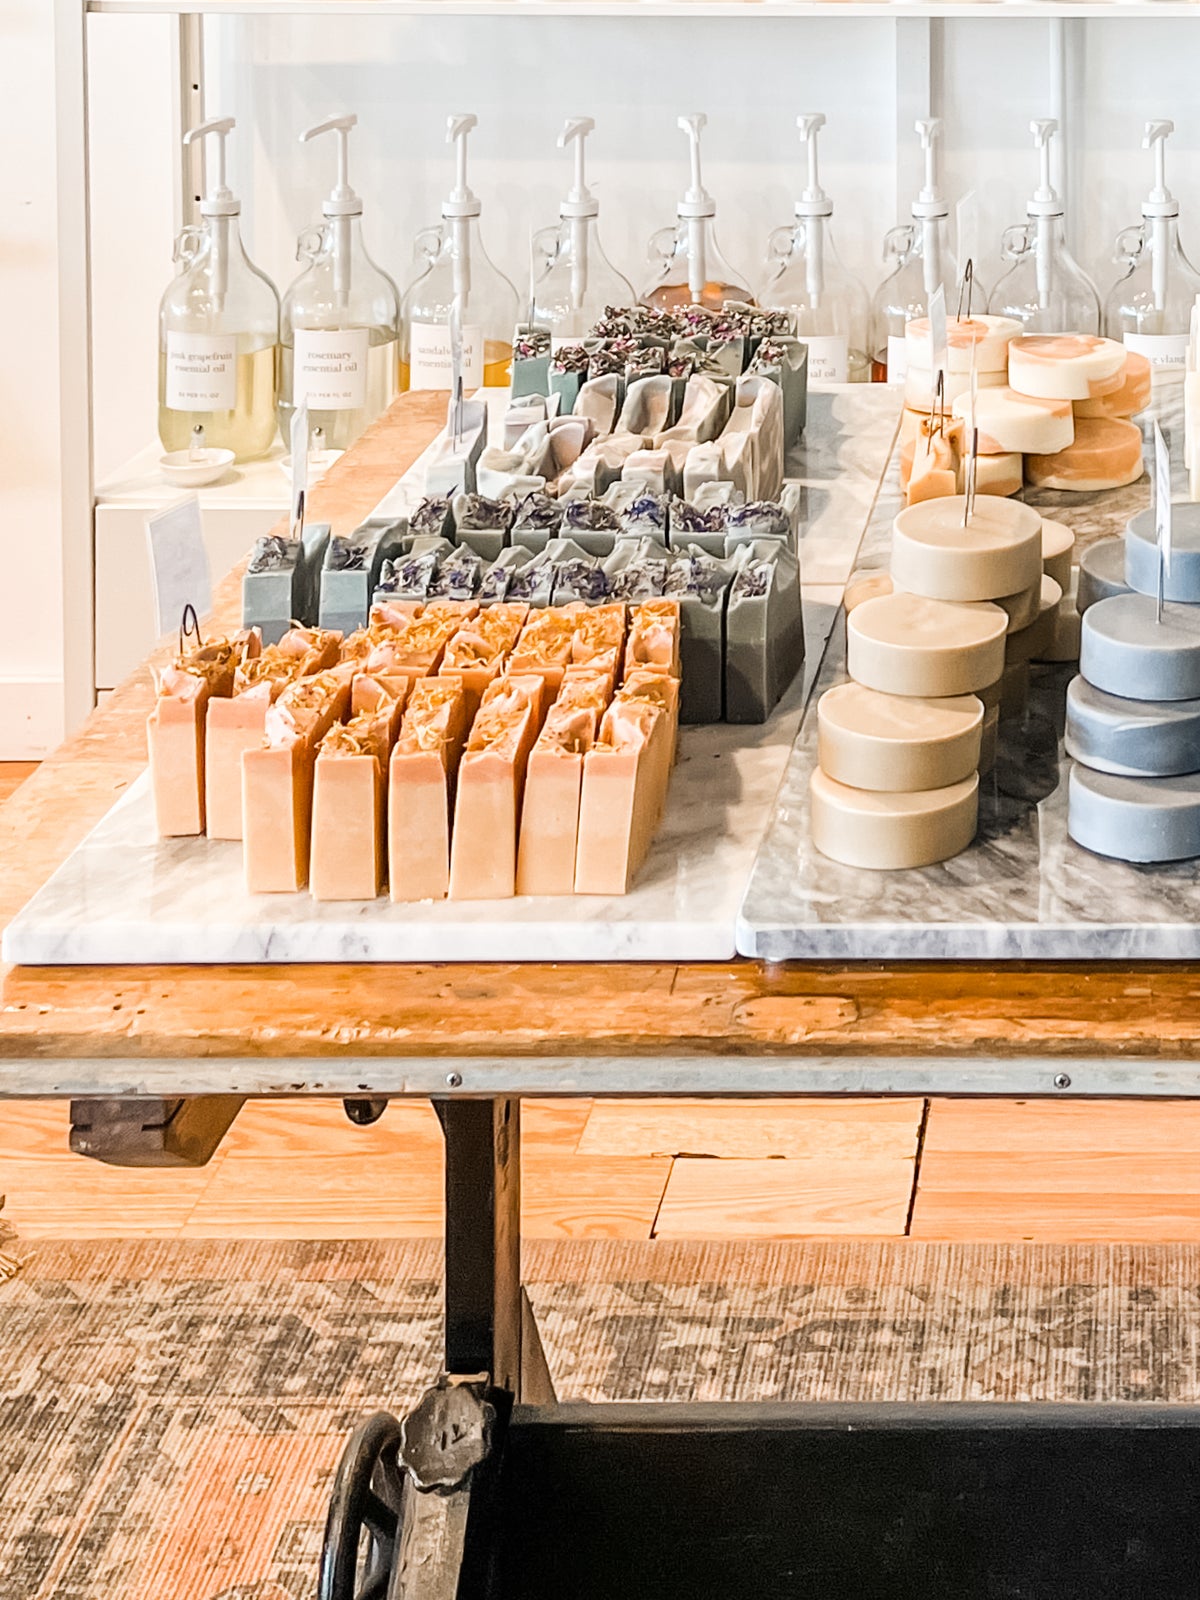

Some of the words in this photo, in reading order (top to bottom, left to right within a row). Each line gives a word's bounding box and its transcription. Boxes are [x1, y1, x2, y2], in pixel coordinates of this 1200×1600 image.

[418, 345, 472, 355] sandalod
[188, 352, 232, 362] grapefruit
[308, 352, 352, 362] rosemary
[175, 364, 210, 373] essential
[212, 363, 225, 373] oil
[303, 362, 341, 372] essential
[344, 362, 357, 372] oil
[418, 360, 452, 368] essentia
[825, 368, 836, 377] oil
